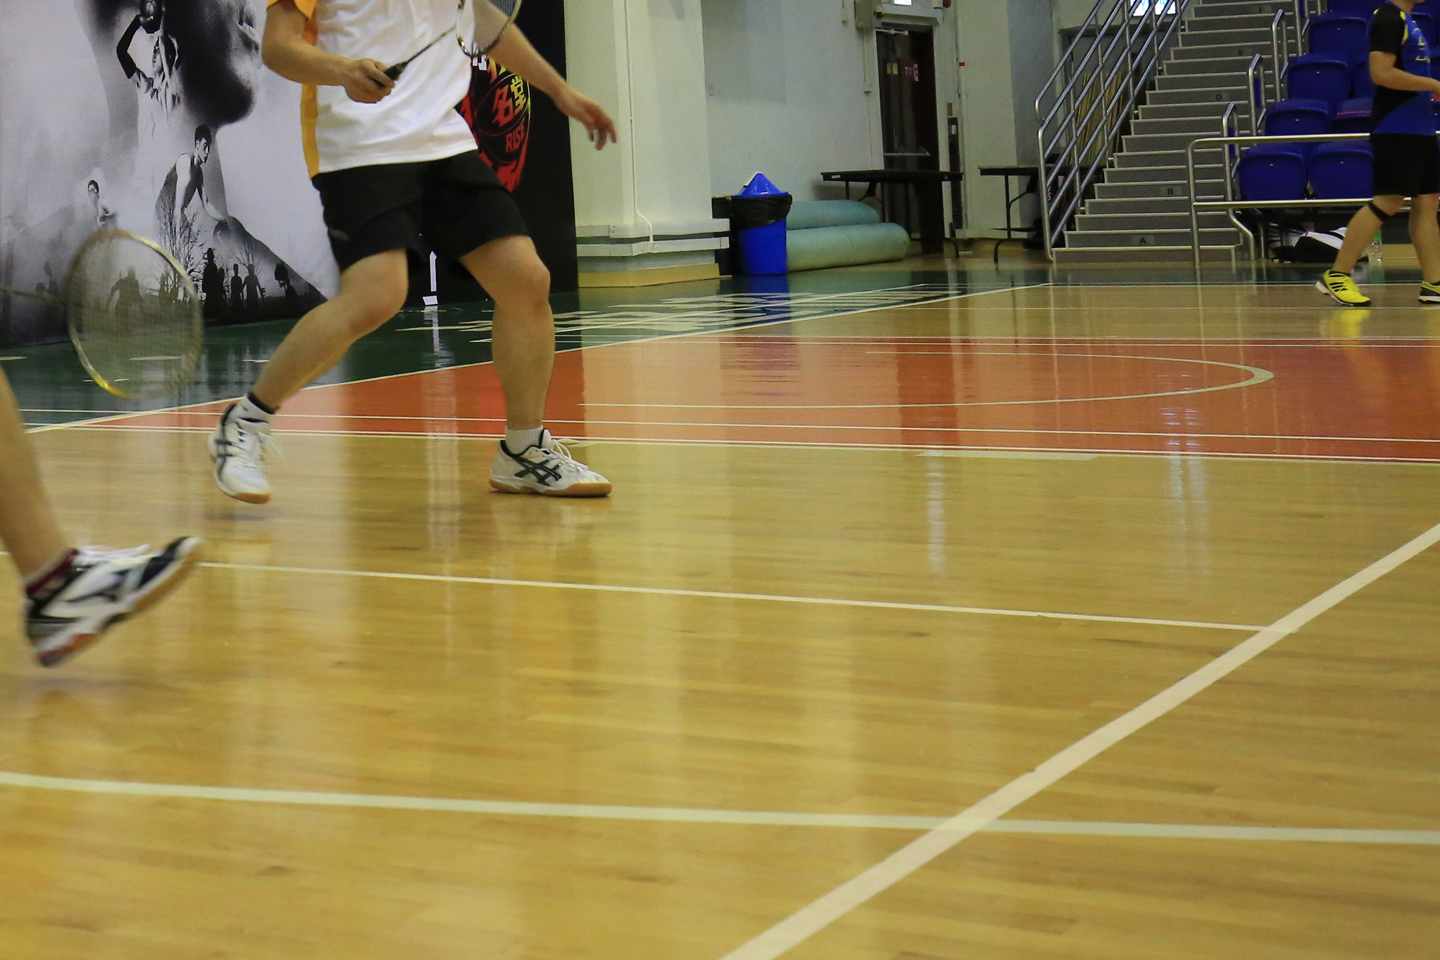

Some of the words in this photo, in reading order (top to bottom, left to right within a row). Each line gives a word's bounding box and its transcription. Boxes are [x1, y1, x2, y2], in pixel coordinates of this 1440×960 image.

[505, 121, 526, 153] RISE
[1167, 187, 1174, 195] B
[1139, 237, 1147, 245] A
